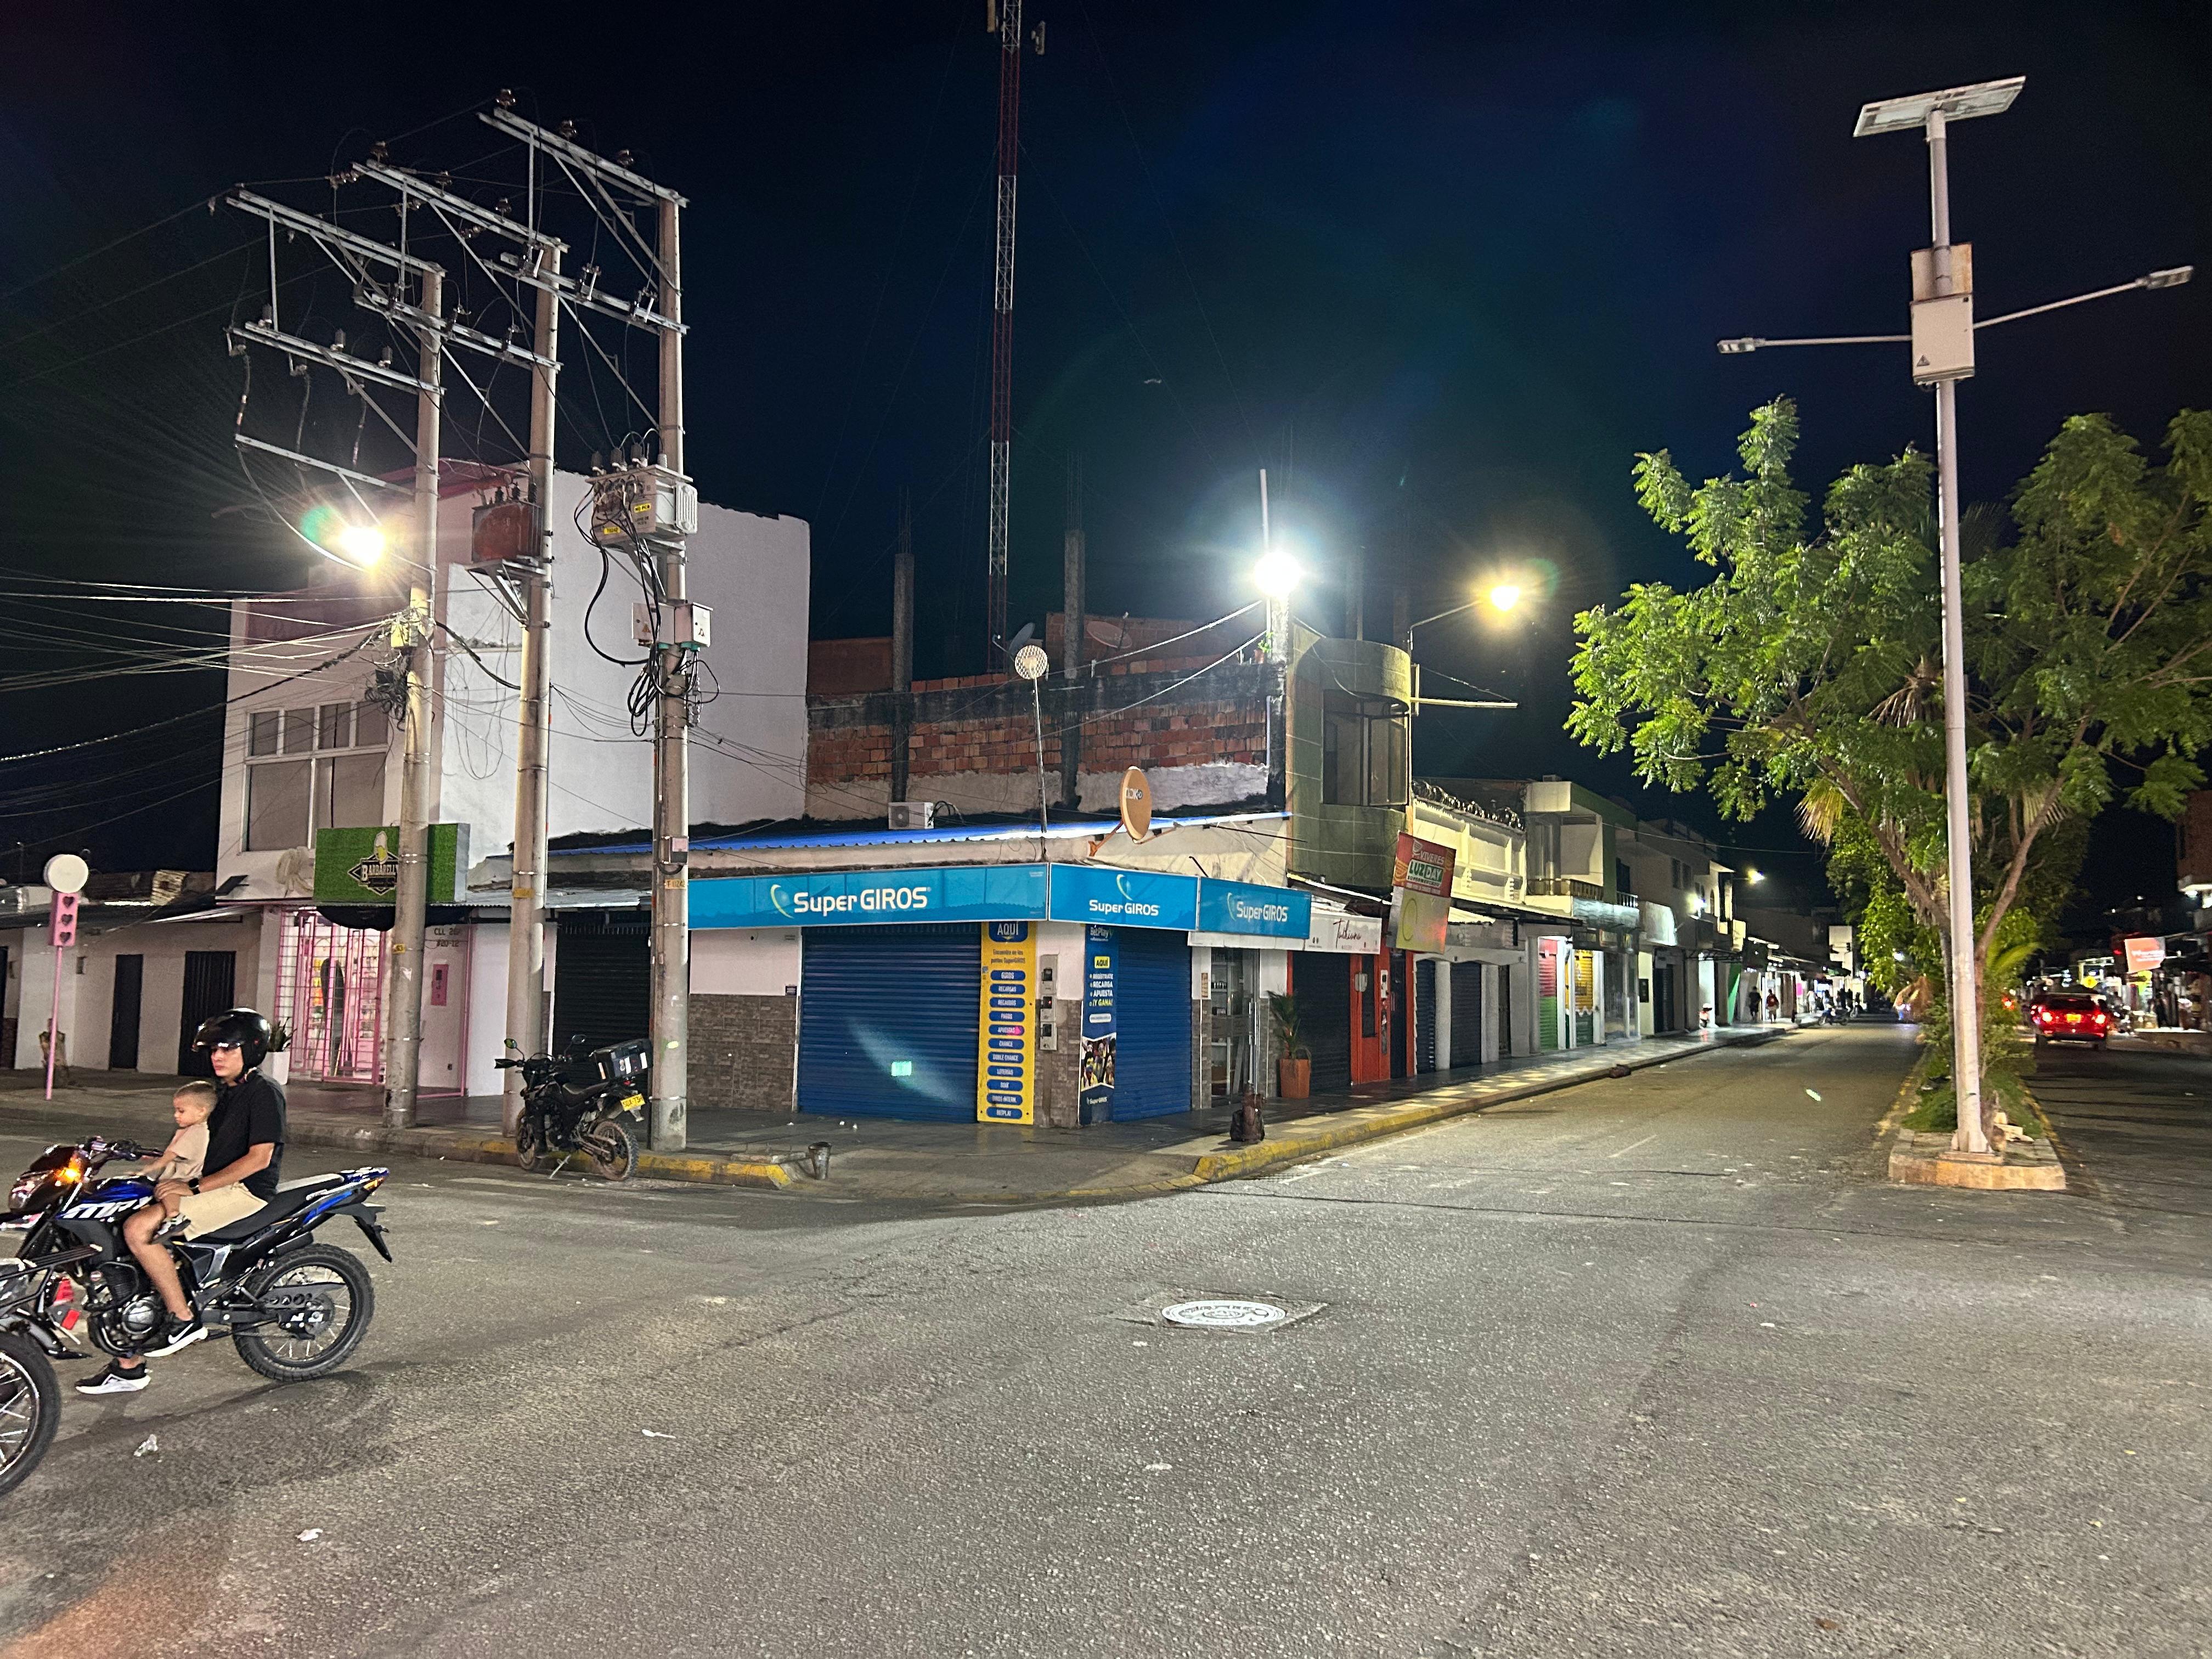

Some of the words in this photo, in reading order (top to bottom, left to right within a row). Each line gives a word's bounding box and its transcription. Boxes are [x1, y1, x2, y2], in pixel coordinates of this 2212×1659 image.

[1420, 850, 1445, 865] VIVERES
[1409, 861, 1425, 877] LUZ
[1425, 866, 1443, 881] DAY
[997, 922, 1019, 935] AQUÍ
[1096, 958, 1108, 967] AQUÍ
[1093, 989, 1113, 997] APUESTA
